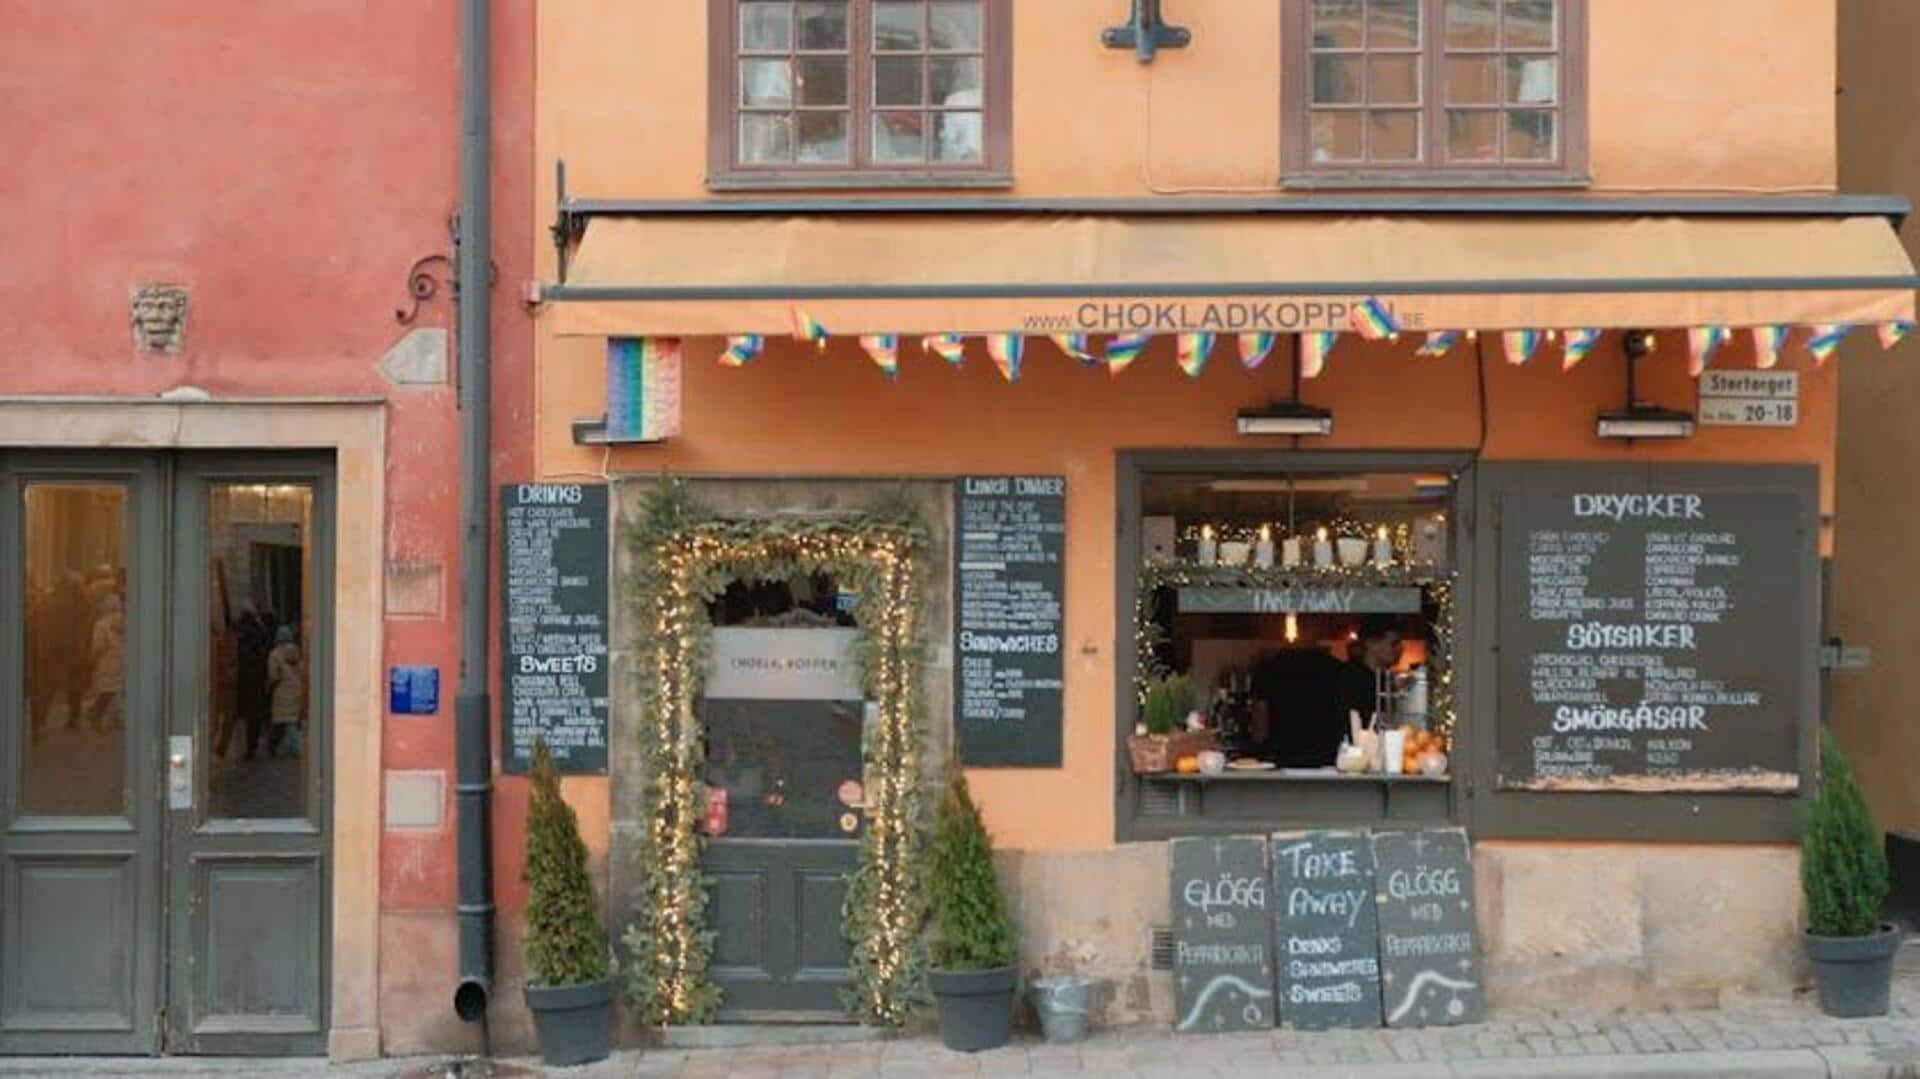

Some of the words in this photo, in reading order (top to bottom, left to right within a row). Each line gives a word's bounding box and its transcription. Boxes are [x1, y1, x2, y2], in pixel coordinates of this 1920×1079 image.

[1709, 375, 1793, 395] Stortorget
[1744, 404, 1793, 421] 20-18
[518, 485, 583, 504] DRINKS
[1015, 477, 1064, 495] DINNER
[1573, 492, 1704, 521] DRYCKER
[960, 631, 1059, 654] SANDWICHES
[1567, 621, 1697, 649] SÖTSAKER
[520, 655, 597, 673] SWEETS
[1553, 700, 1708, 733] SMÖRGÅSAR
[1184, 872, 1265, 913] GLÖGG
[1389, 865, 1462, 900] GLÖGG
[1288, 886, 1367, 928] AWAY
[1410, 902, 1443, 923] MED
[1288, 936, 1342, 955] DRINKS
[1289, 959, 1378, 979] SANDWICHES
[1290, 981, 1363, 1004] SWEETS
